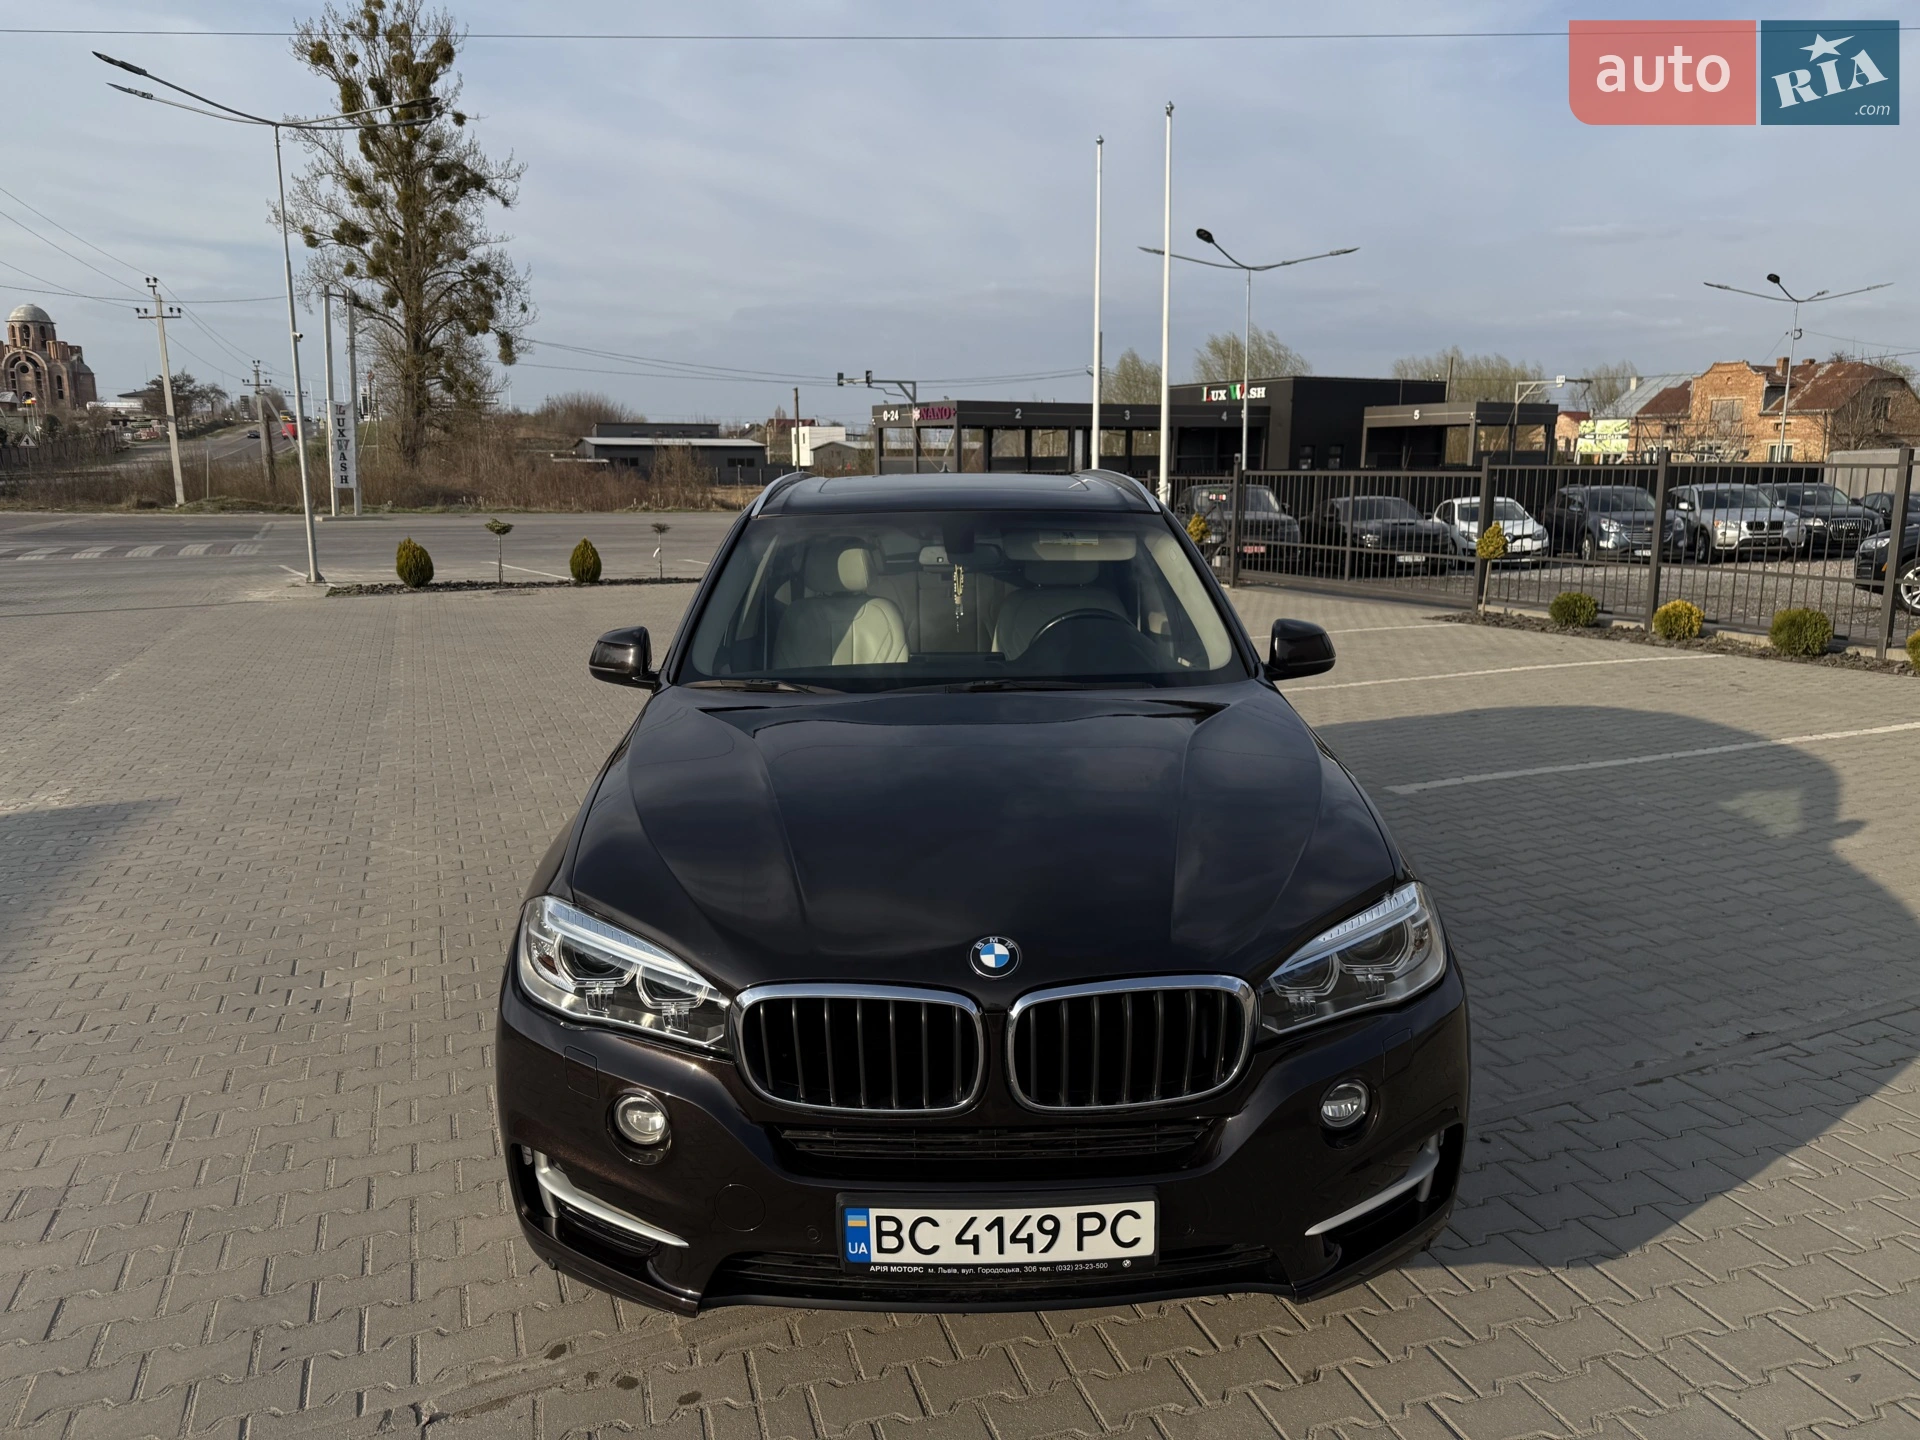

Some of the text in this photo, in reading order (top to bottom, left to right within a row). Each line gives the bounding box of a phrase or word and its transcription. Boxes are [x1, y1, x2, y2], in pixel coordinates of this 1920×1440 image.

[883, 410, 899, 421] 0-24
[1015, 408, 1022, 419] 2
[1124, 410, 1130, 420] 3
[1221, 411, 1227, 421] 4
[1413, 409, 1420, 420] 5
[976, 937, 1014, 949] BMW
[875, 1209, 1141, 1255] BC 4149 PC
[849, 1242, 868, 1255] UA
[1055, 1264, 1074, 1272] (032)
